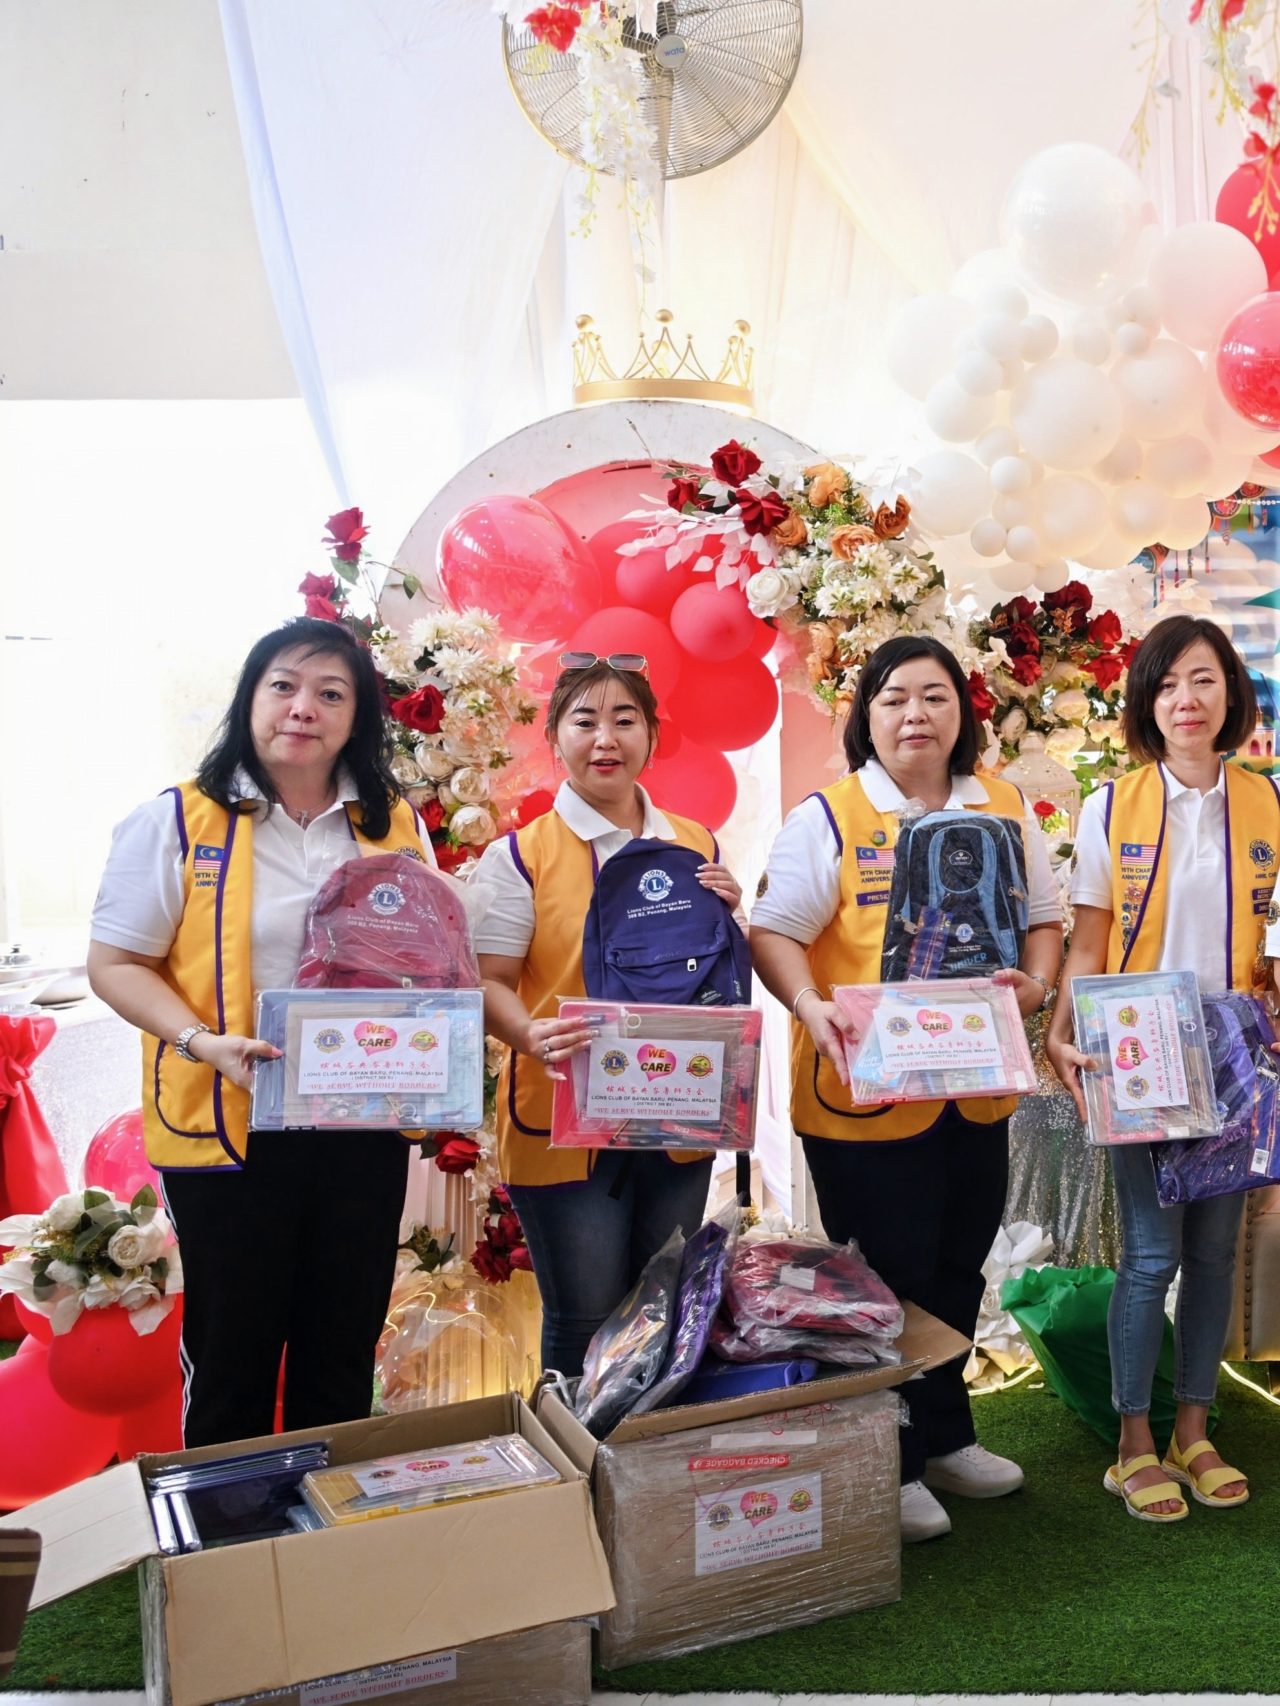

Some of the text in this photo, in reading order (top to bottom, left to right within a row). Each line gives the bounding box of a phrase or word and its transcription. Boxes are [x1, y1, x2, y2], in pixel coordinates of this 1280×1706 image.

[652, 879, 662, 891] L
[925, 1011, 941, 1020] WE
[366, 1025, 386, 1034] WE
[922, 1022, 949, 1031] CARE
[358, 1038, 392, 1047] CARE
[648, 1049, 666, 1058] WE
[1118, 1047, 1127, 1061] WE
[1130, 1040, 1141, 1066] CARE
[640, 1062, 672, 1072] CARE
[705, 1456, 786, 1467] CHECKED BAGGAGE
[750, 1492, 768, 1504] WE
[745, 1505, 774, 1520] CARE
[304, 1683, 324, 1692] LIONS
[324, 1680, 342, 1689] CLUB
[422, 1656, 452, 1666] MALAYSIA
[329, 1689, 358, 1703] SERVE
[359, 1680, 403, 1697] WITHOUT
